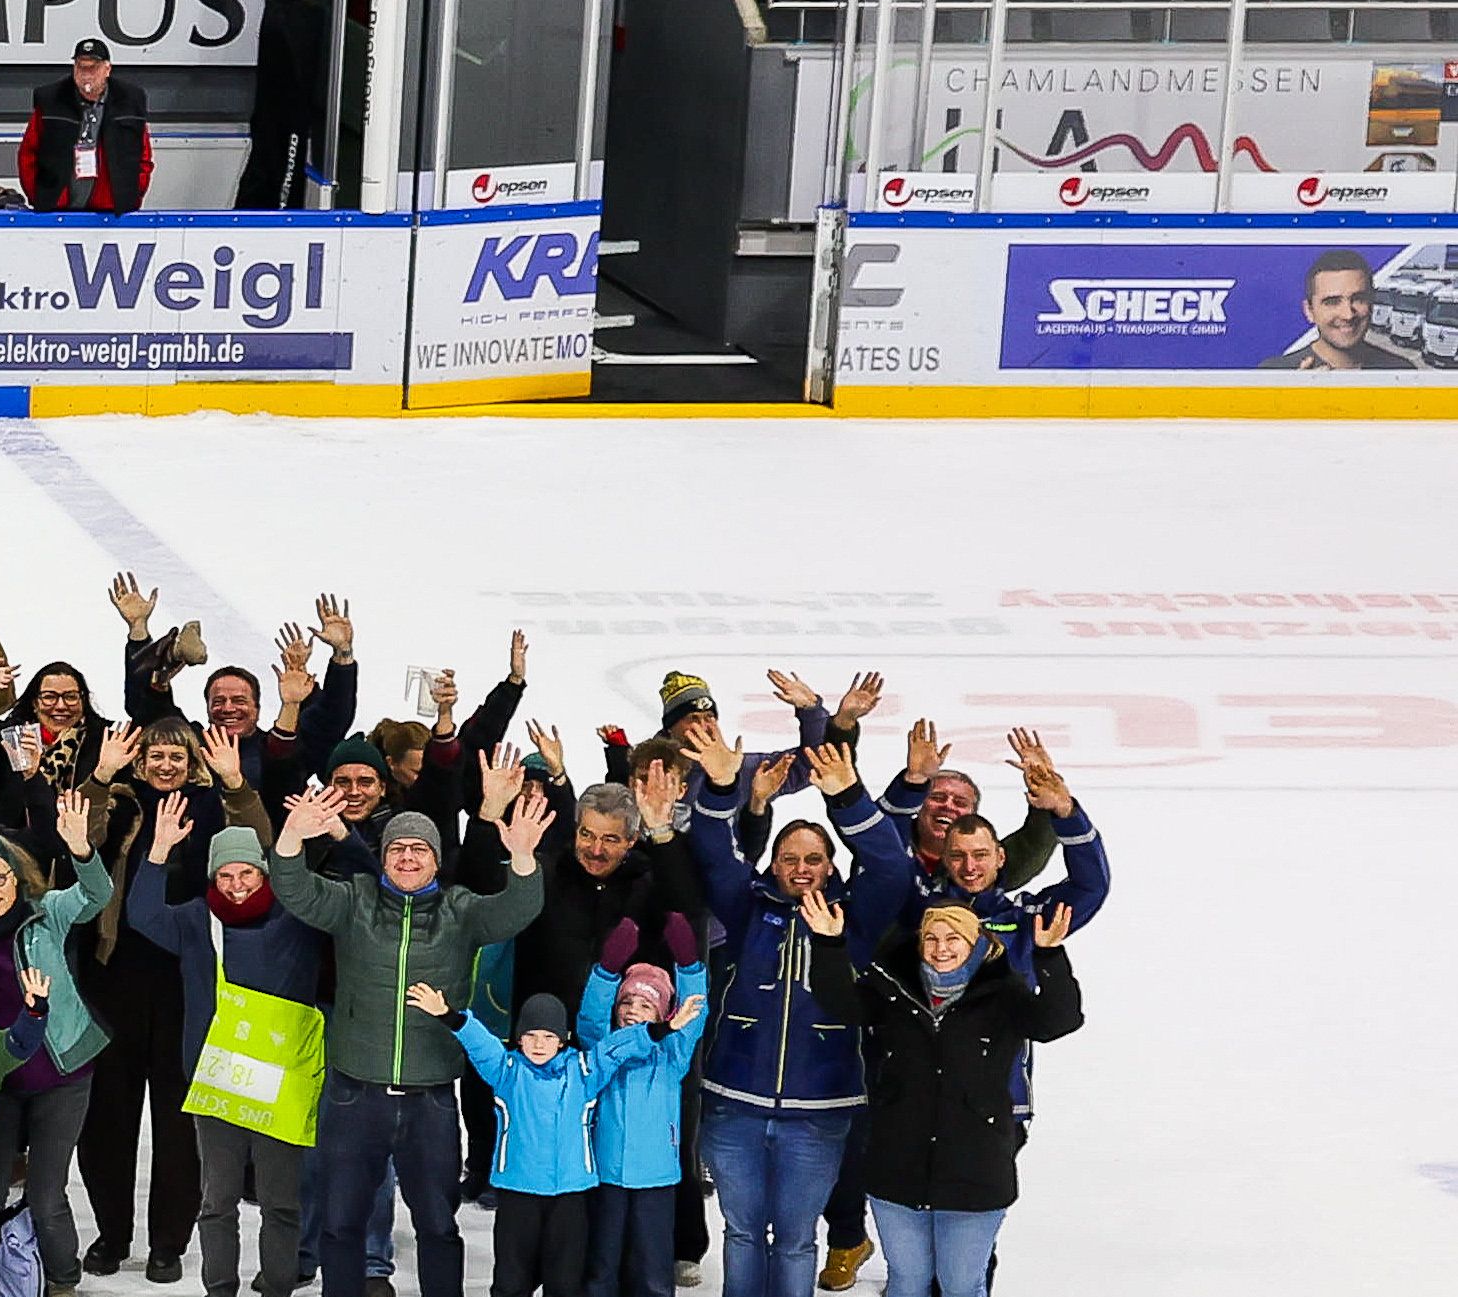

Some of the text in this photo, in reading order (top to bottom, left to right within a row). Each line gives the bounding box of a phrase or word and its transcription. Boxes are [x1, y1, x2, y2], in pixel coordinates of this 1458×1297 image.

[64, 242, 325, 328] Weigl
[519, 307, 597, 321] PERFO
[1037, 279, 1237, 323] SCHECK
[417, 344, 447, 371] WE
[908, 346, 940, 372] US
